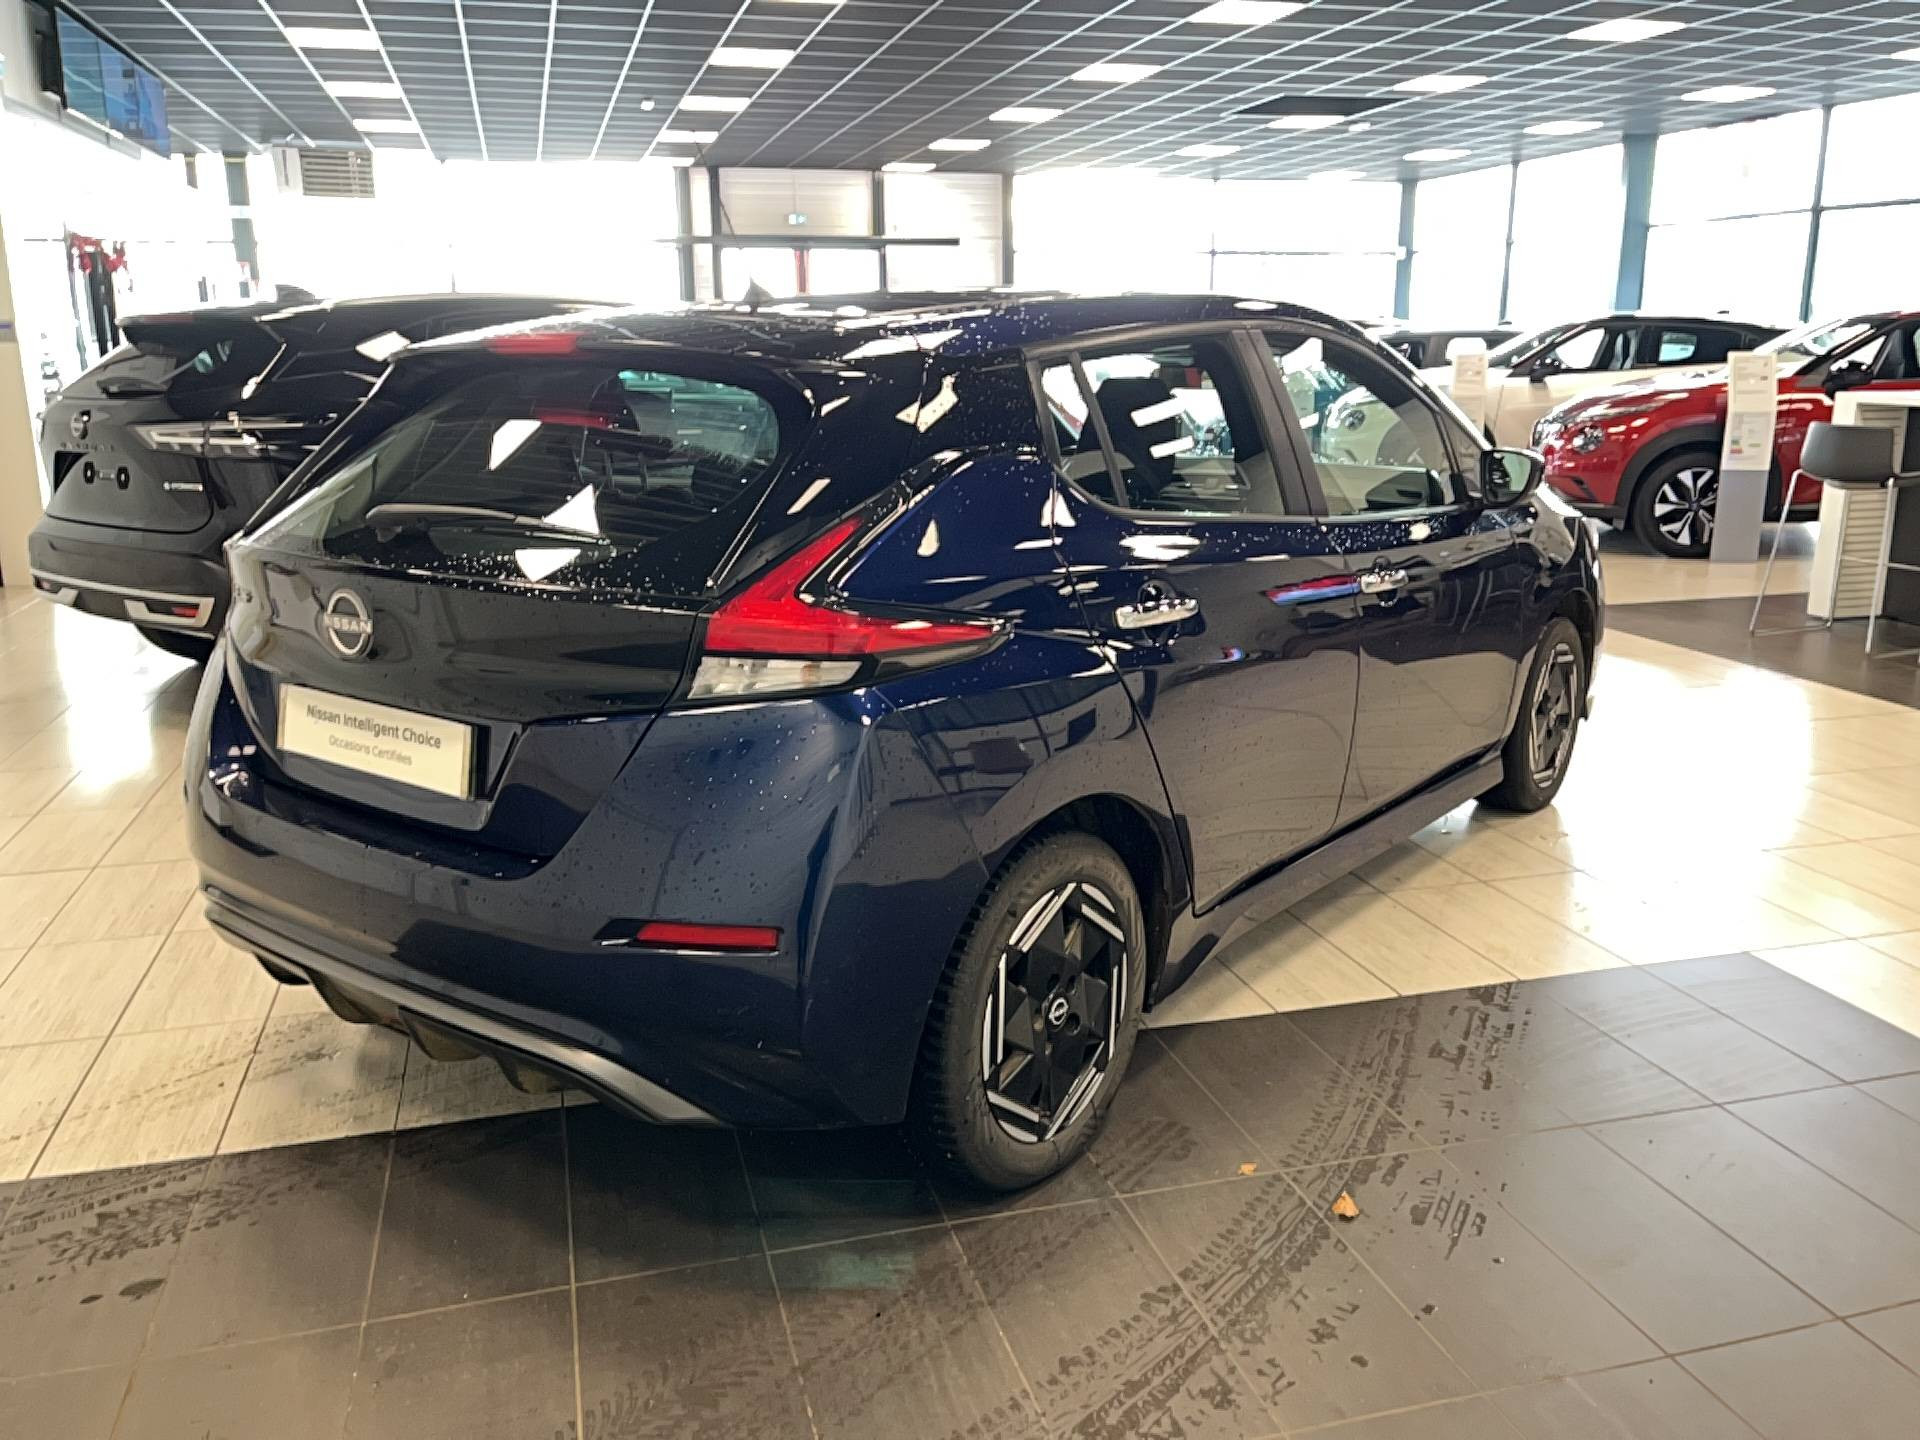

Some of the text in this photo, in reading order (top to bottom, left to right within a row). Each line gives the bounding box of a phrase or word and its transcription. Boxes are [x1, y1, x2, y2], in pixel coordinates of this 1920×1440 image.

[307, 704, 441, 749] Nissan Intelligent Choice
[328, 734, 370, 754] Occasions
